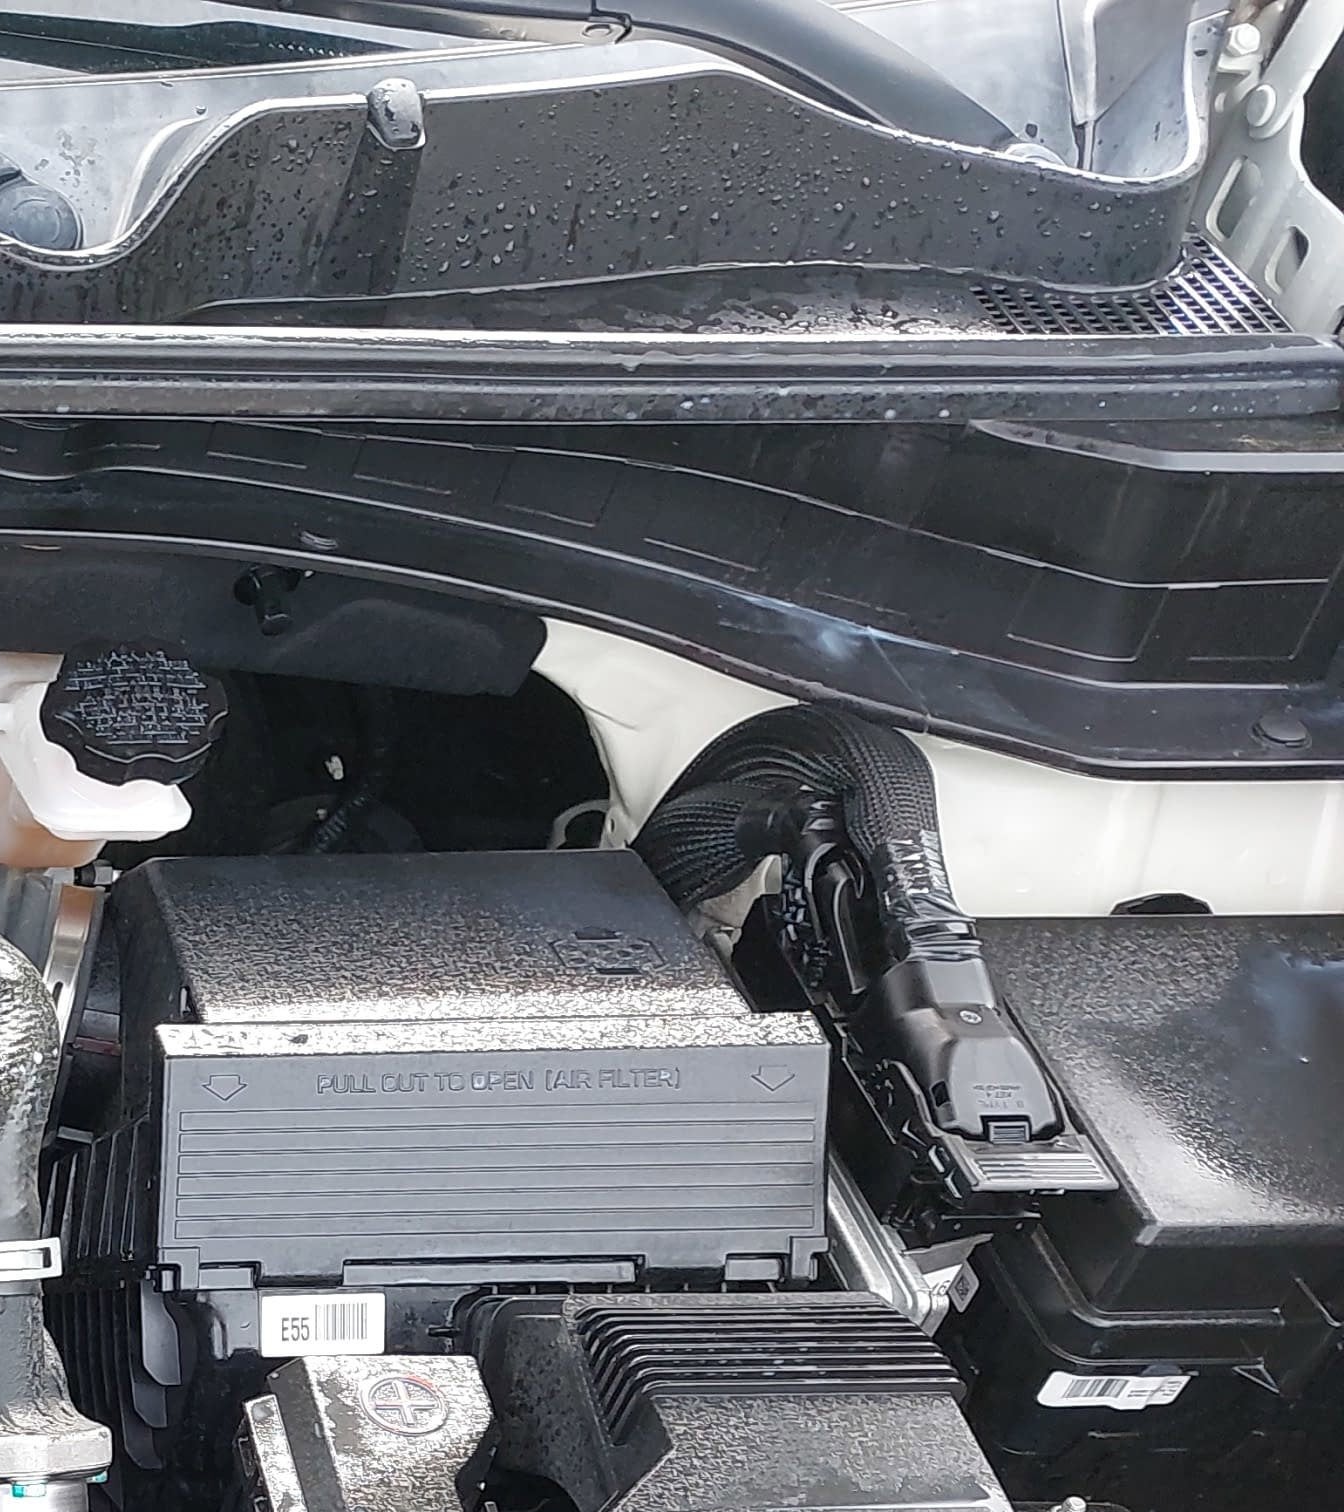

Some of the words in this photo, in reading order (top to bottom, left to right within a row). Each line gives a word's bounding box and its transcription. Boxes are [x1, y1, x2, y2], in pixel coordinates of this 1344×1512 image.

[317, 1075, 376, 1094] PULL
[381, 1074, 429, 1093] OUT
[432, 1073, 465, 1091] TO
[470, 1070, 535, 1090] OPEN
[281, 1318, 310, 1342] E55
